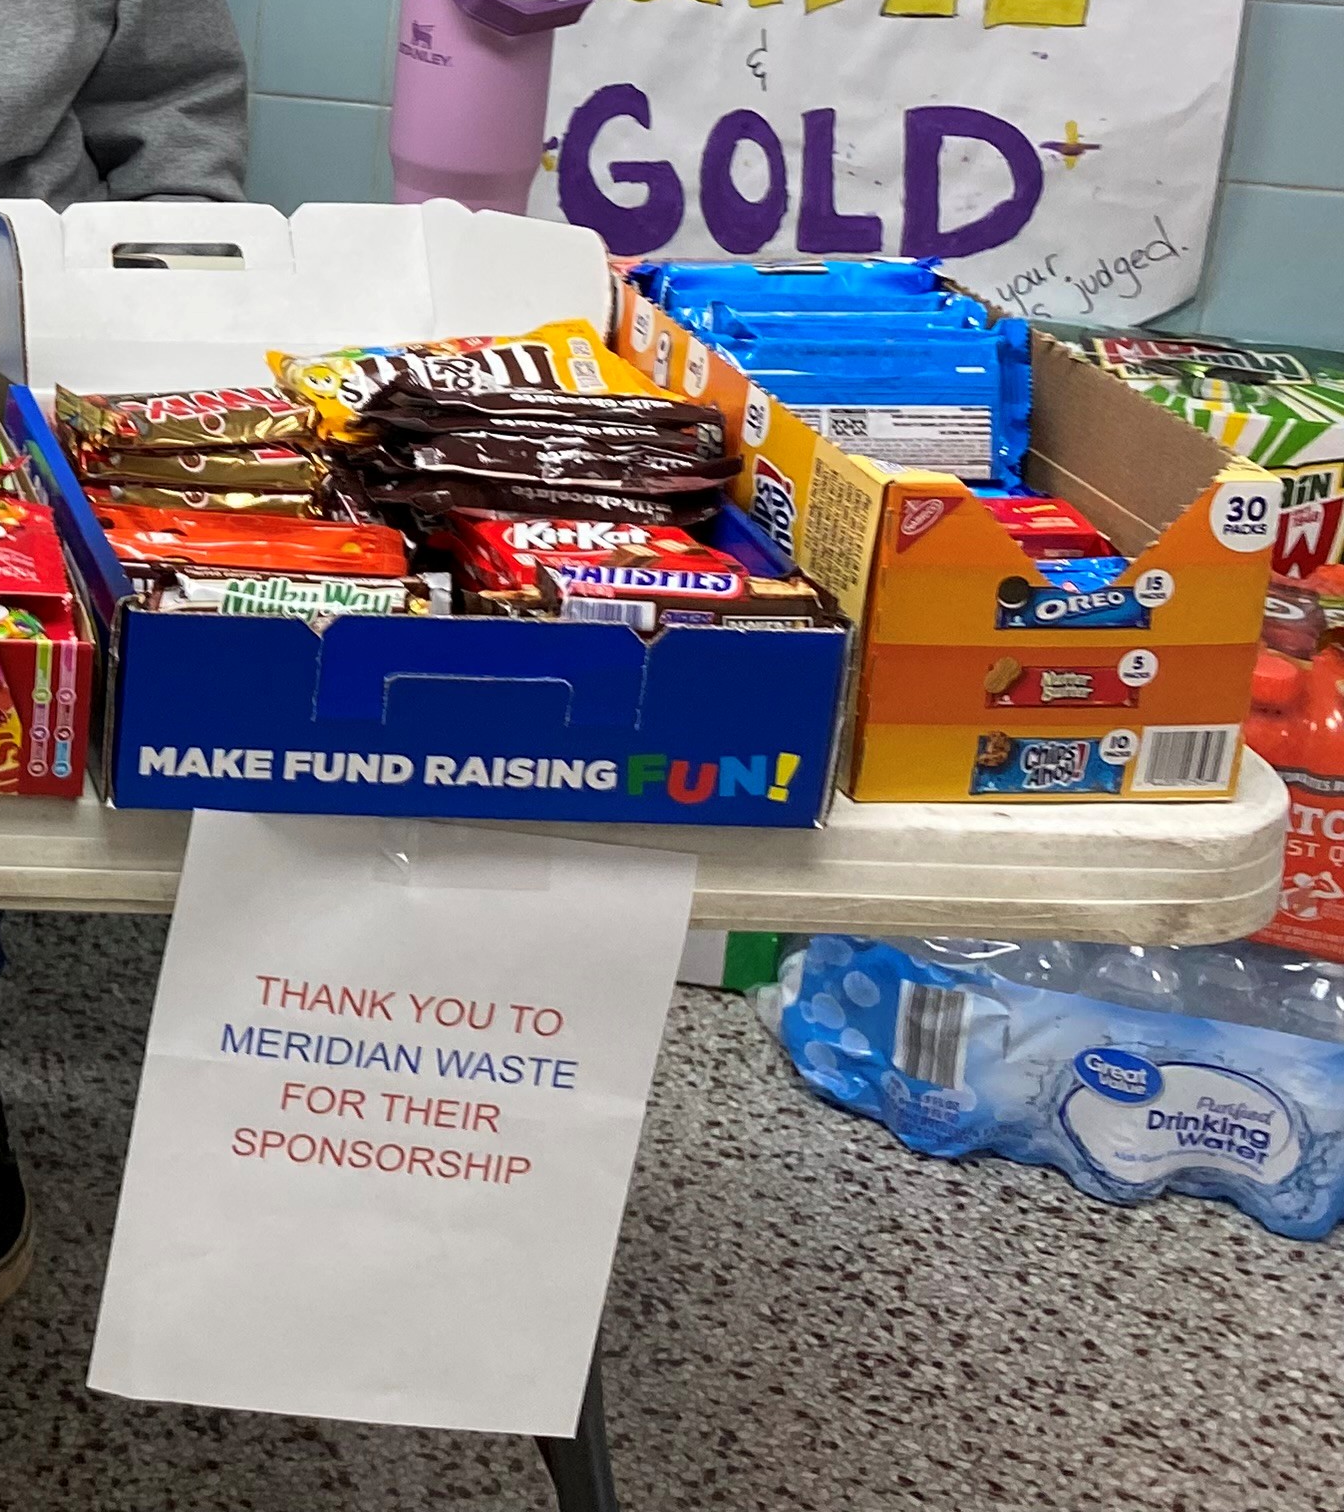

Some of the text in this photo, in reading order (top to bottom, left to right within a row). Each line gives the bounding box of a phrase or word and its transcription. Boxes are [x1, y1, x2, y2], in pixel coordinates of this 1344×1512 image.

[557, 83, 1044, 260] GOLD
[1226, 495, 1267, 522] 30
[1221, 522, 1268, 536] PACKS
[221, 578, 395, 616] Milky Way
[1146, 576, 1162, 591] 15
[1035, 590, 1126, 621] OREO
[1133, 655, 1144, 669] 5
[1022, 742, 1077, 770] Chips
[1108, 735, 1128, 749] 10
[138, 745, 801, 803] MAKE FUND RAISING FUN!
[256, 974, 565, 1037] THANK YOU TO
[220, 1023, 579, 1089] MERIDIAN WASTE
[1084, 1053, 1147, 1085] Great
[280, 1081, 502, 1134] FOR THEIR
[1146, 1109, 1272, 1148] Drinking
[231, 1127, 533, 1185] SPONSORSHIP
[1176, 1131, 1269, 1164] Water
